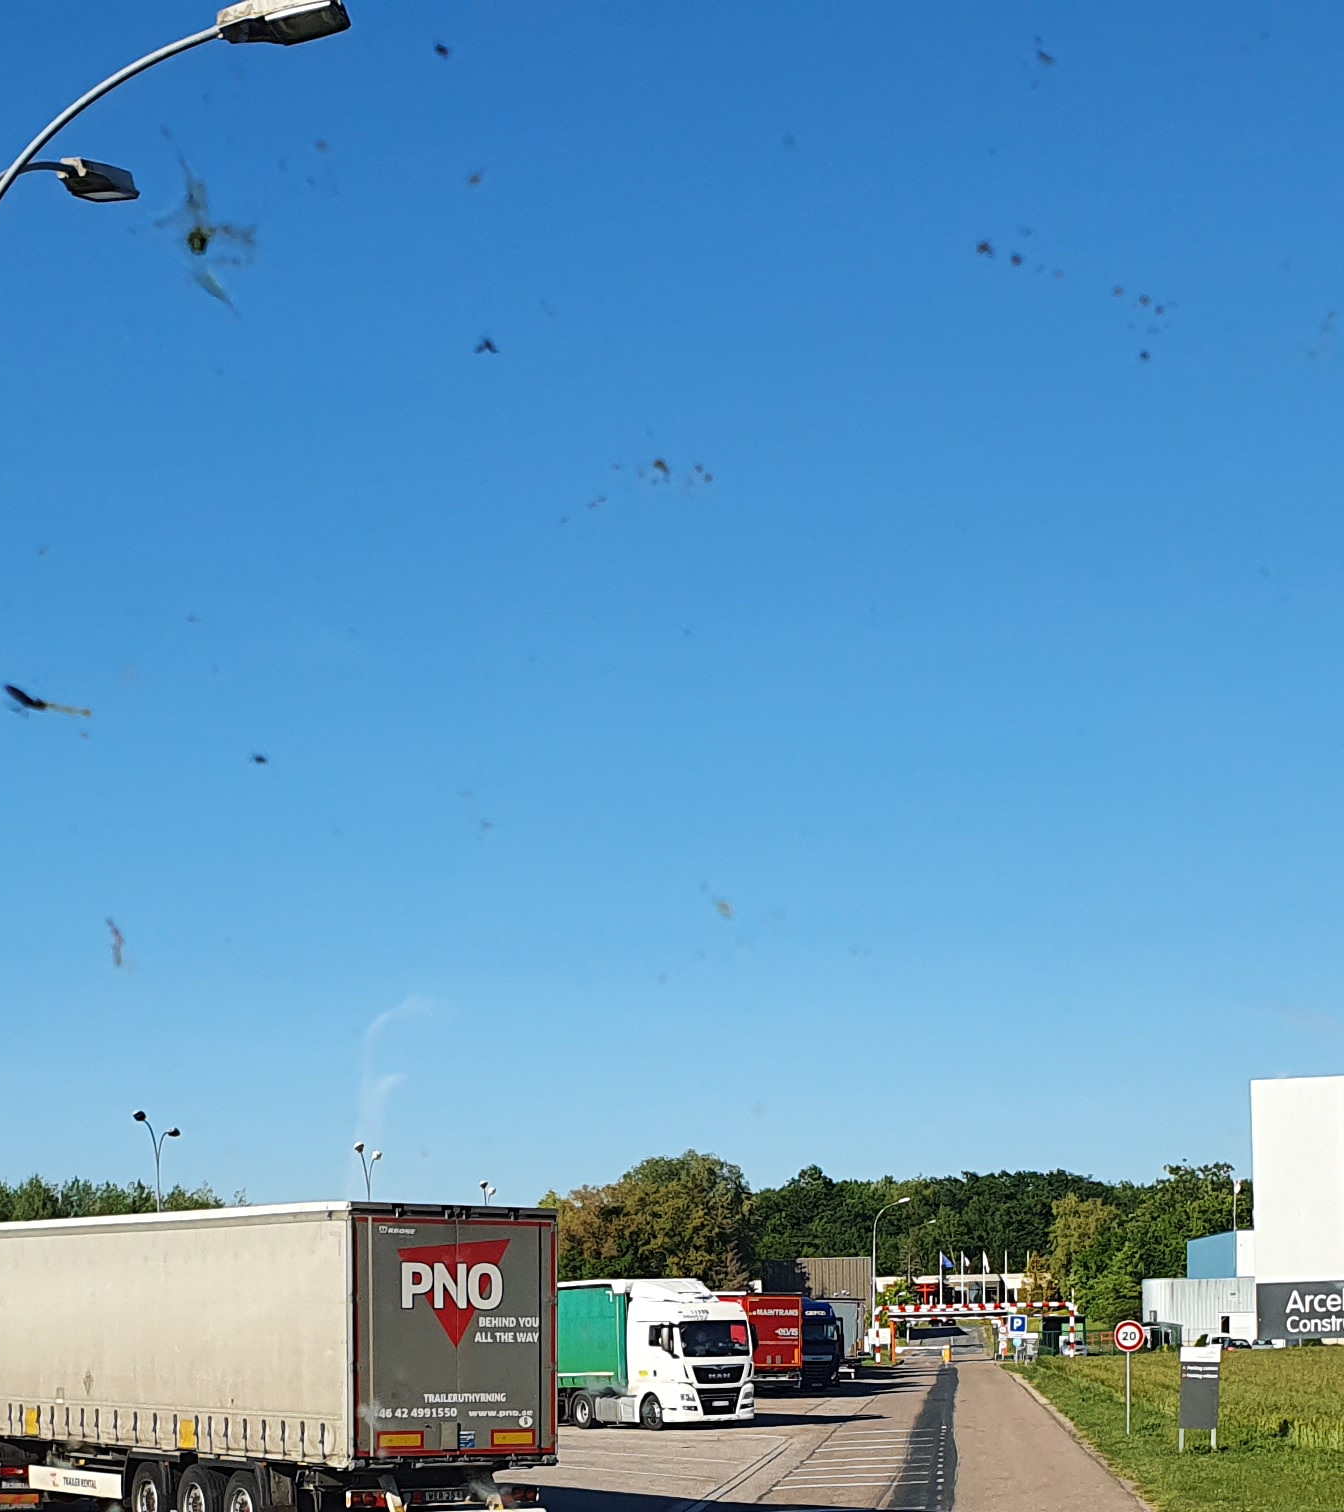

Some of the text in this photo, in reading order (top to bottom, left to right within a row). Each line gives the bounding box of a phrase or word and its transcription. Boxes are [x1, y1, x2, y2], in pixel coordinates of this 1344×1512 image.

[401, 1261, 504, 1311] PNO
[478, 1316, 540, 1328] BEHIND YOU
[1013, 1318, 1023, 1330] P
[474, 1332, 539, 1343] ALL THE WAY
[1121, 1331, 1137, 1341] 20
[708, 1372, 731, 1380] MAN
[394, 1408, 409, 1418] 42
[410, 1407, 458, 1418] 4991550
